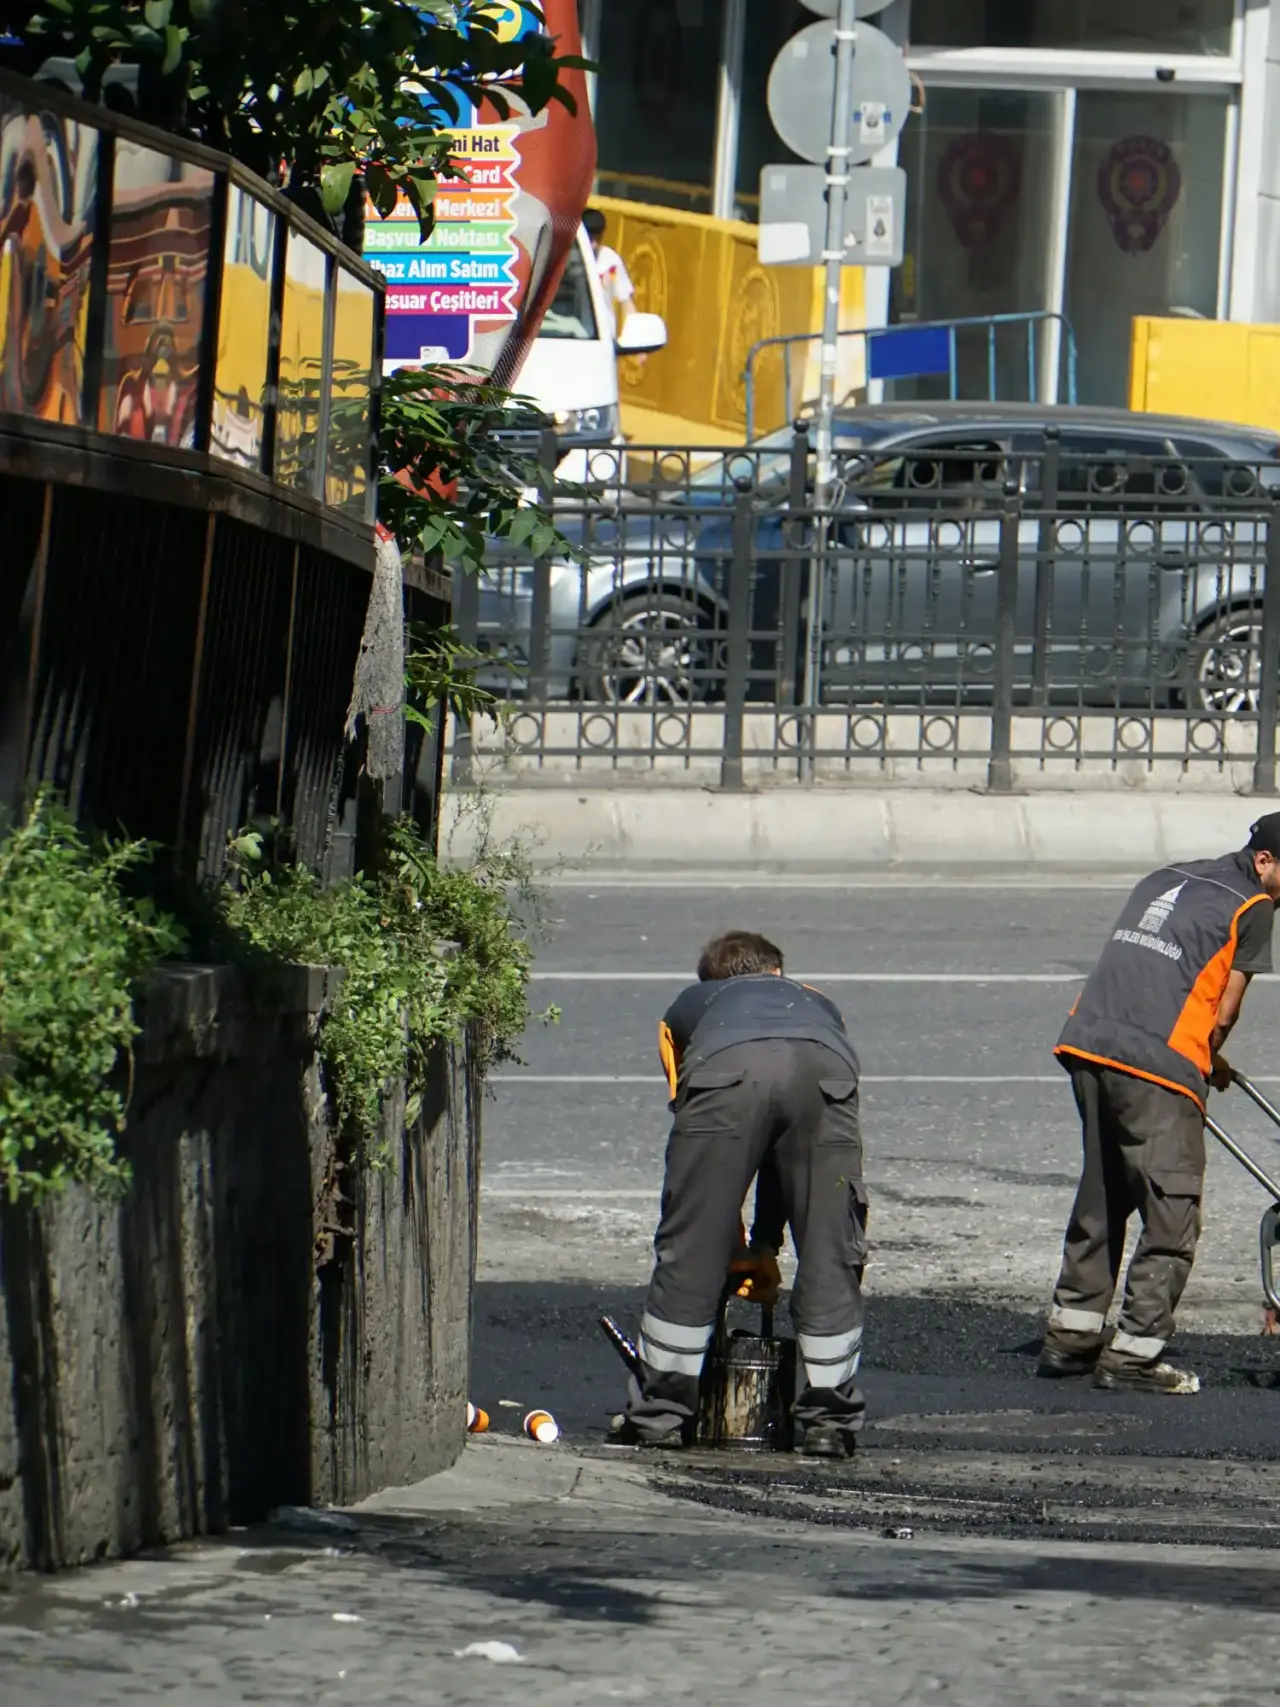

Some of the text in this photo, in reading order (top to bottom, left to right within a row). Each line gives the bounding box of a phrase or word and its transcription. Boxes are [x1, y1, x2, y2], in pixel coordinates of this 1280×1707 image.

[472, 135, 500, 152] Hat
[435, 197, 500, 217] Merkezi
[366, 228, 499, 250] Başvur Noktası
[408, 259, 447, 278] Alım
[450, 259, 499, 278] Satım
[385, 290, 499, 312] esuar Çeşitleri
